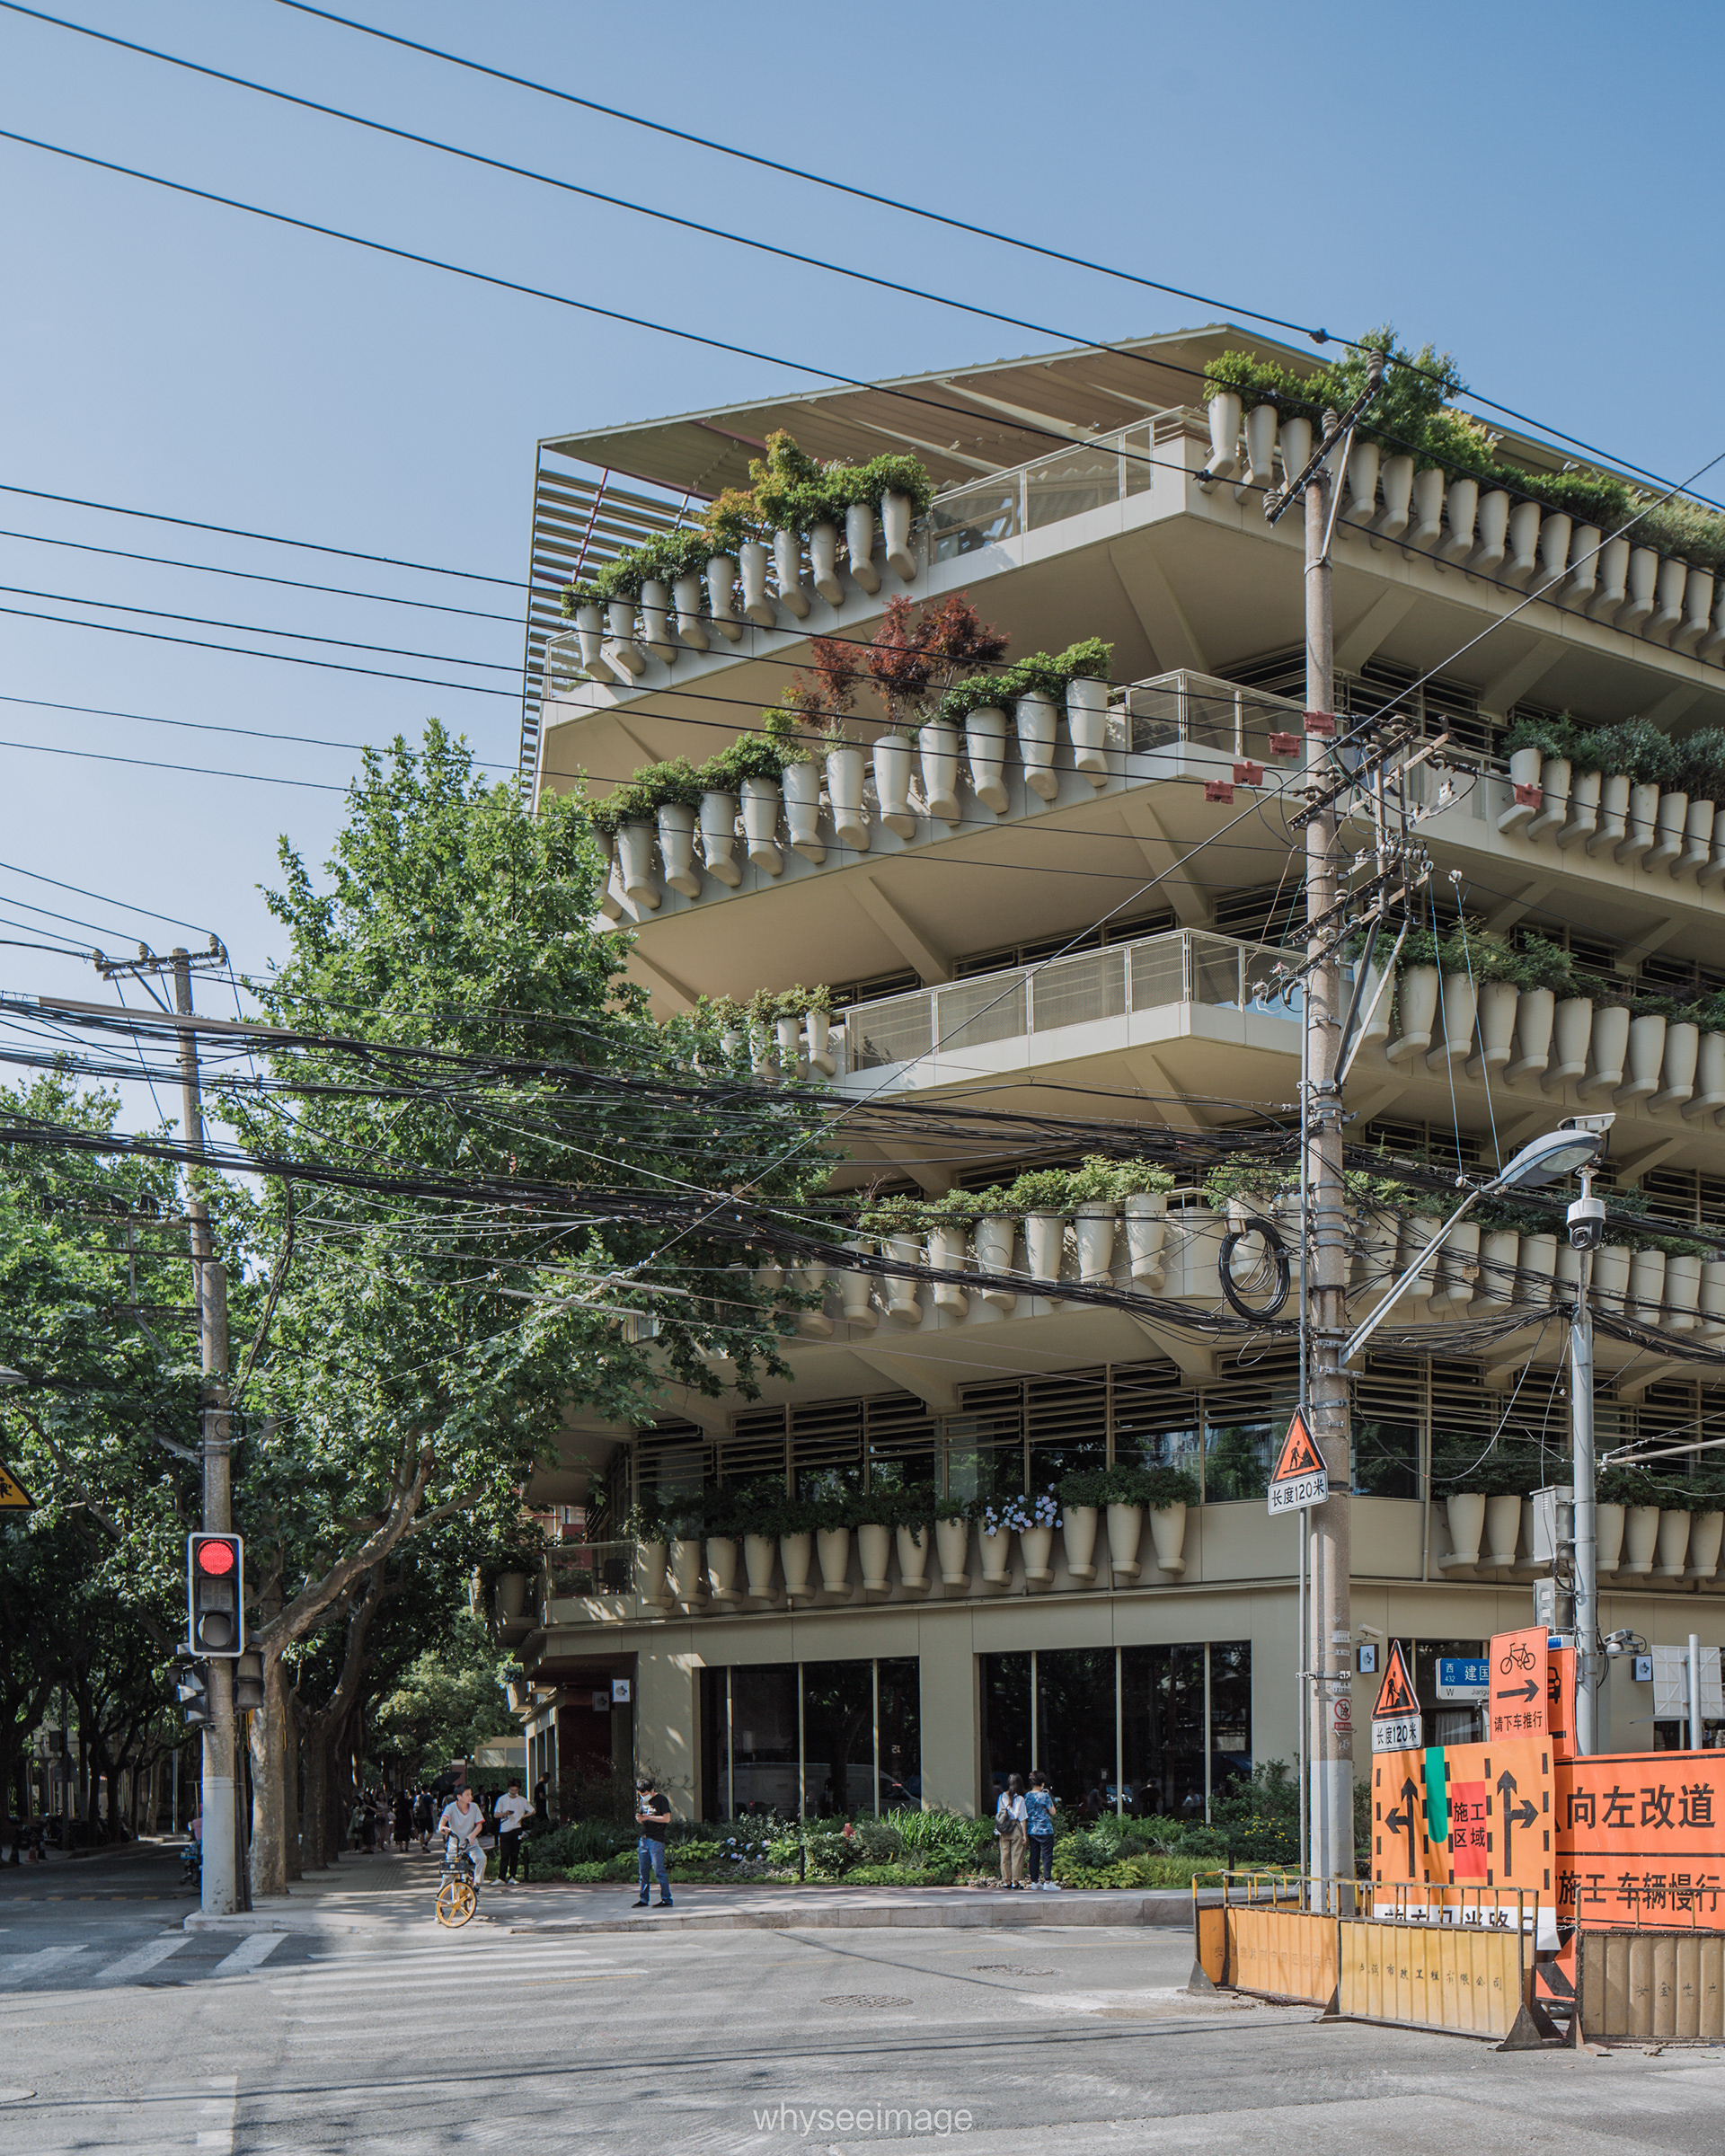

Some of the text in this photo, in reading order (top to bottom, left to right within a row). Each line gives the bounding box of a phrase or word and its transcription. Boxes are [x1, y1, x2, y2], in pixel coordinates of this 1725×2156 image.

[1271, 1478, 1325, 1507] 长度120米
[1446, 1663, 1455, 1674] 西
[1446, 1688, 1455, 1697] W
[1494, 1710, 1543, 1733] 请下车推行
[1376, 1722, 1417, 1745] 长度120米
[1453, 1801, 1485, 1823] 施工
[1555, 1782, 1716, 1833] 向左改道
[1454, 1825, 1486, 1848] 区域
[1555, 1869, 1606, 1905] 施工
